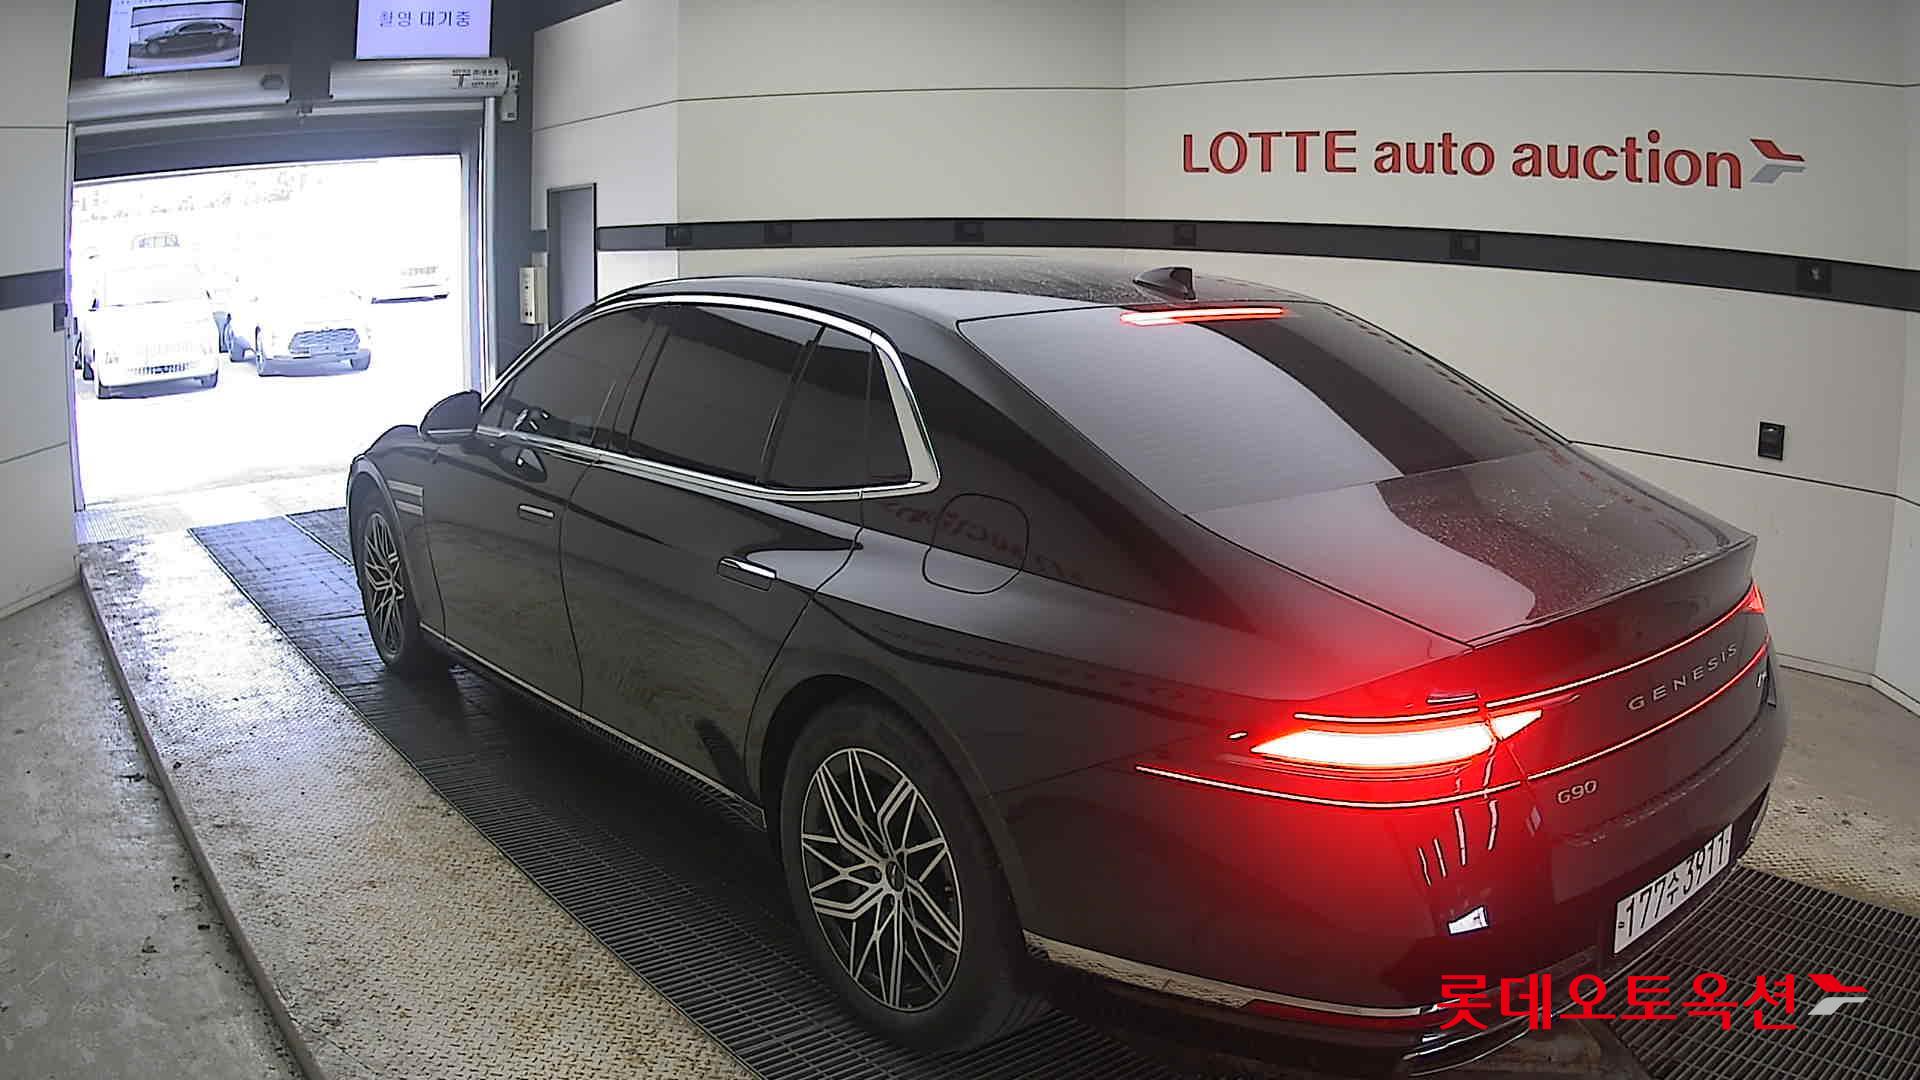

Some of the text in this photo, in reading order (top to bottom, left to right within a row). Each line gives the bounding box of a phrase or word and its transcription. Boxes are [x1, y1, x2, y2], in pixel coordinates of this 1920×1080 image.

[420, 10, 471, 28] 대기중
[1183, 129, 1743, 189] LOTTE auto auction
[1627, 642, 1737, 711] GENESIS
[1557, 780, 1598, 804] G90
